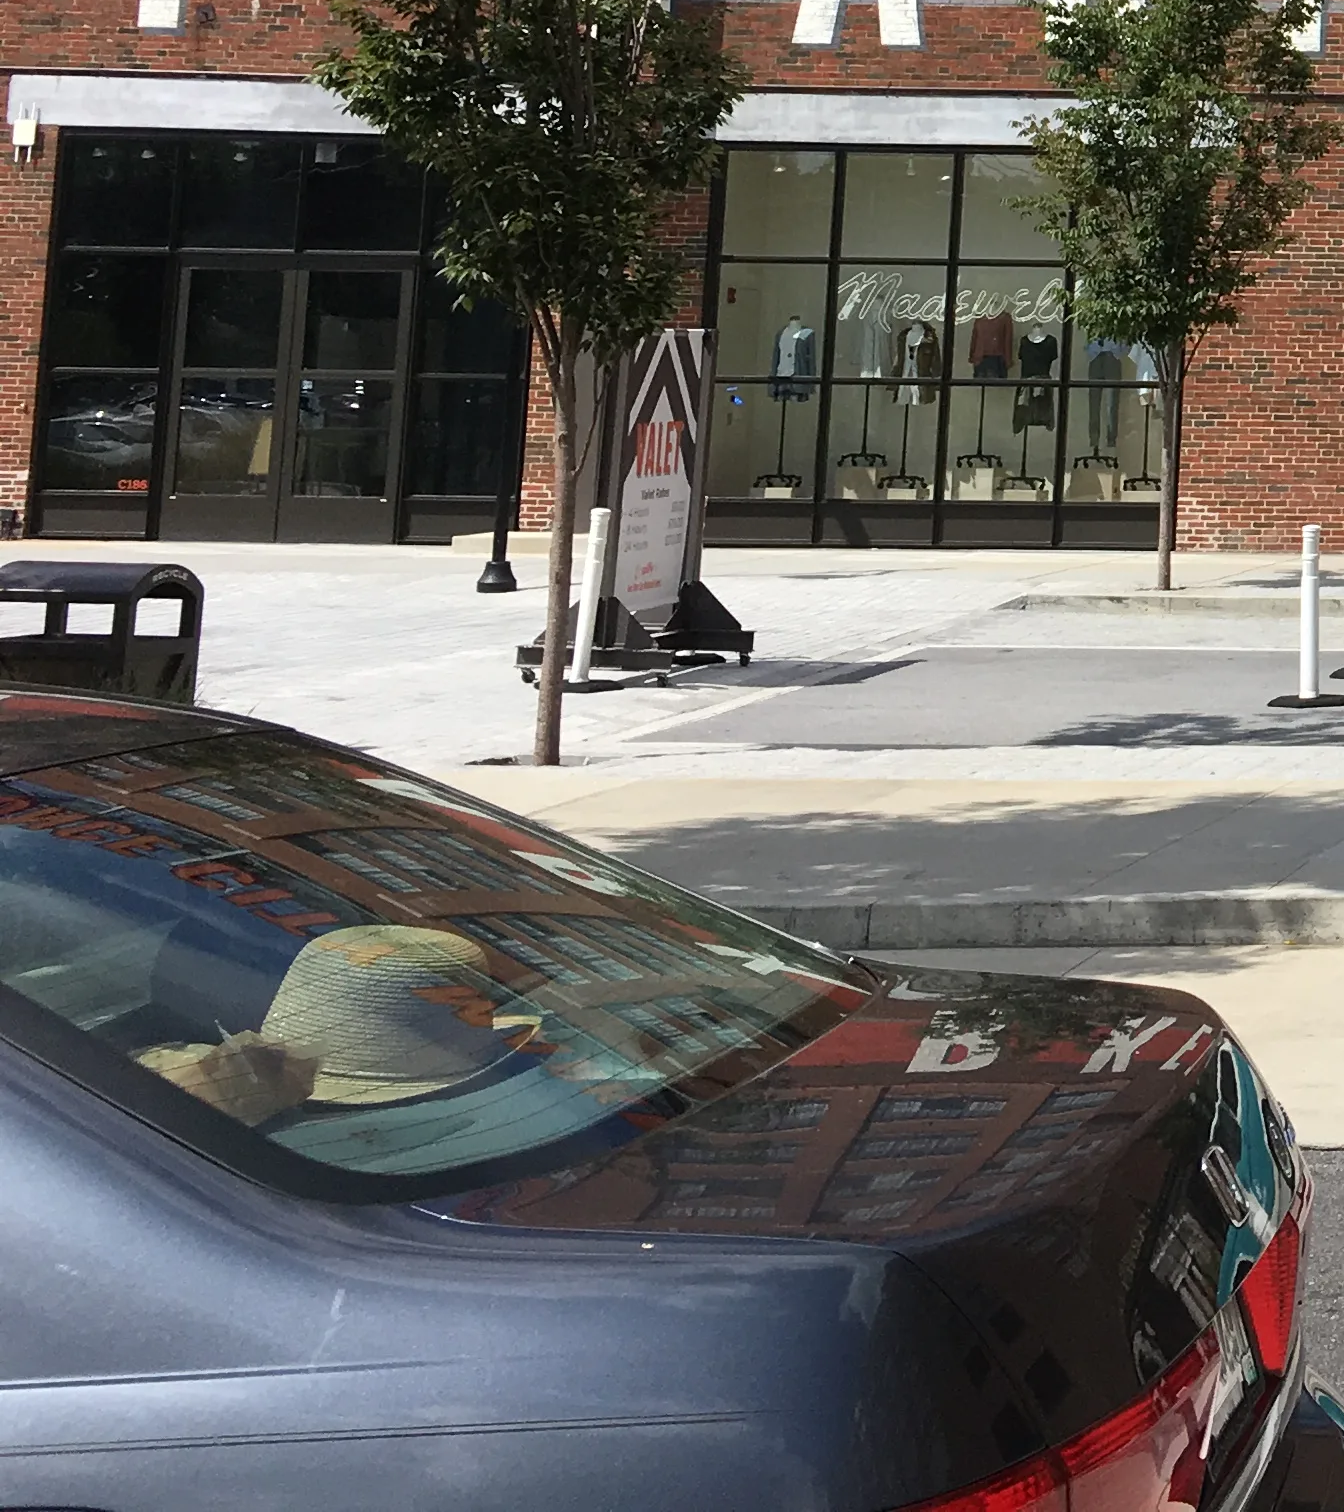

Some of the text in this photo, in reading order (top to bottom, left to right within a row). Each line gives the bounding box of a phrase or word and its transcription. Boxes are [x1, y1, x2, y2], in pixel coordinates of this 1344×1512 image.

[635, 420, 684, 478] VALET
[117, 479, 148, 490] C186
[151, 569, 189, 582] RECYCLE
